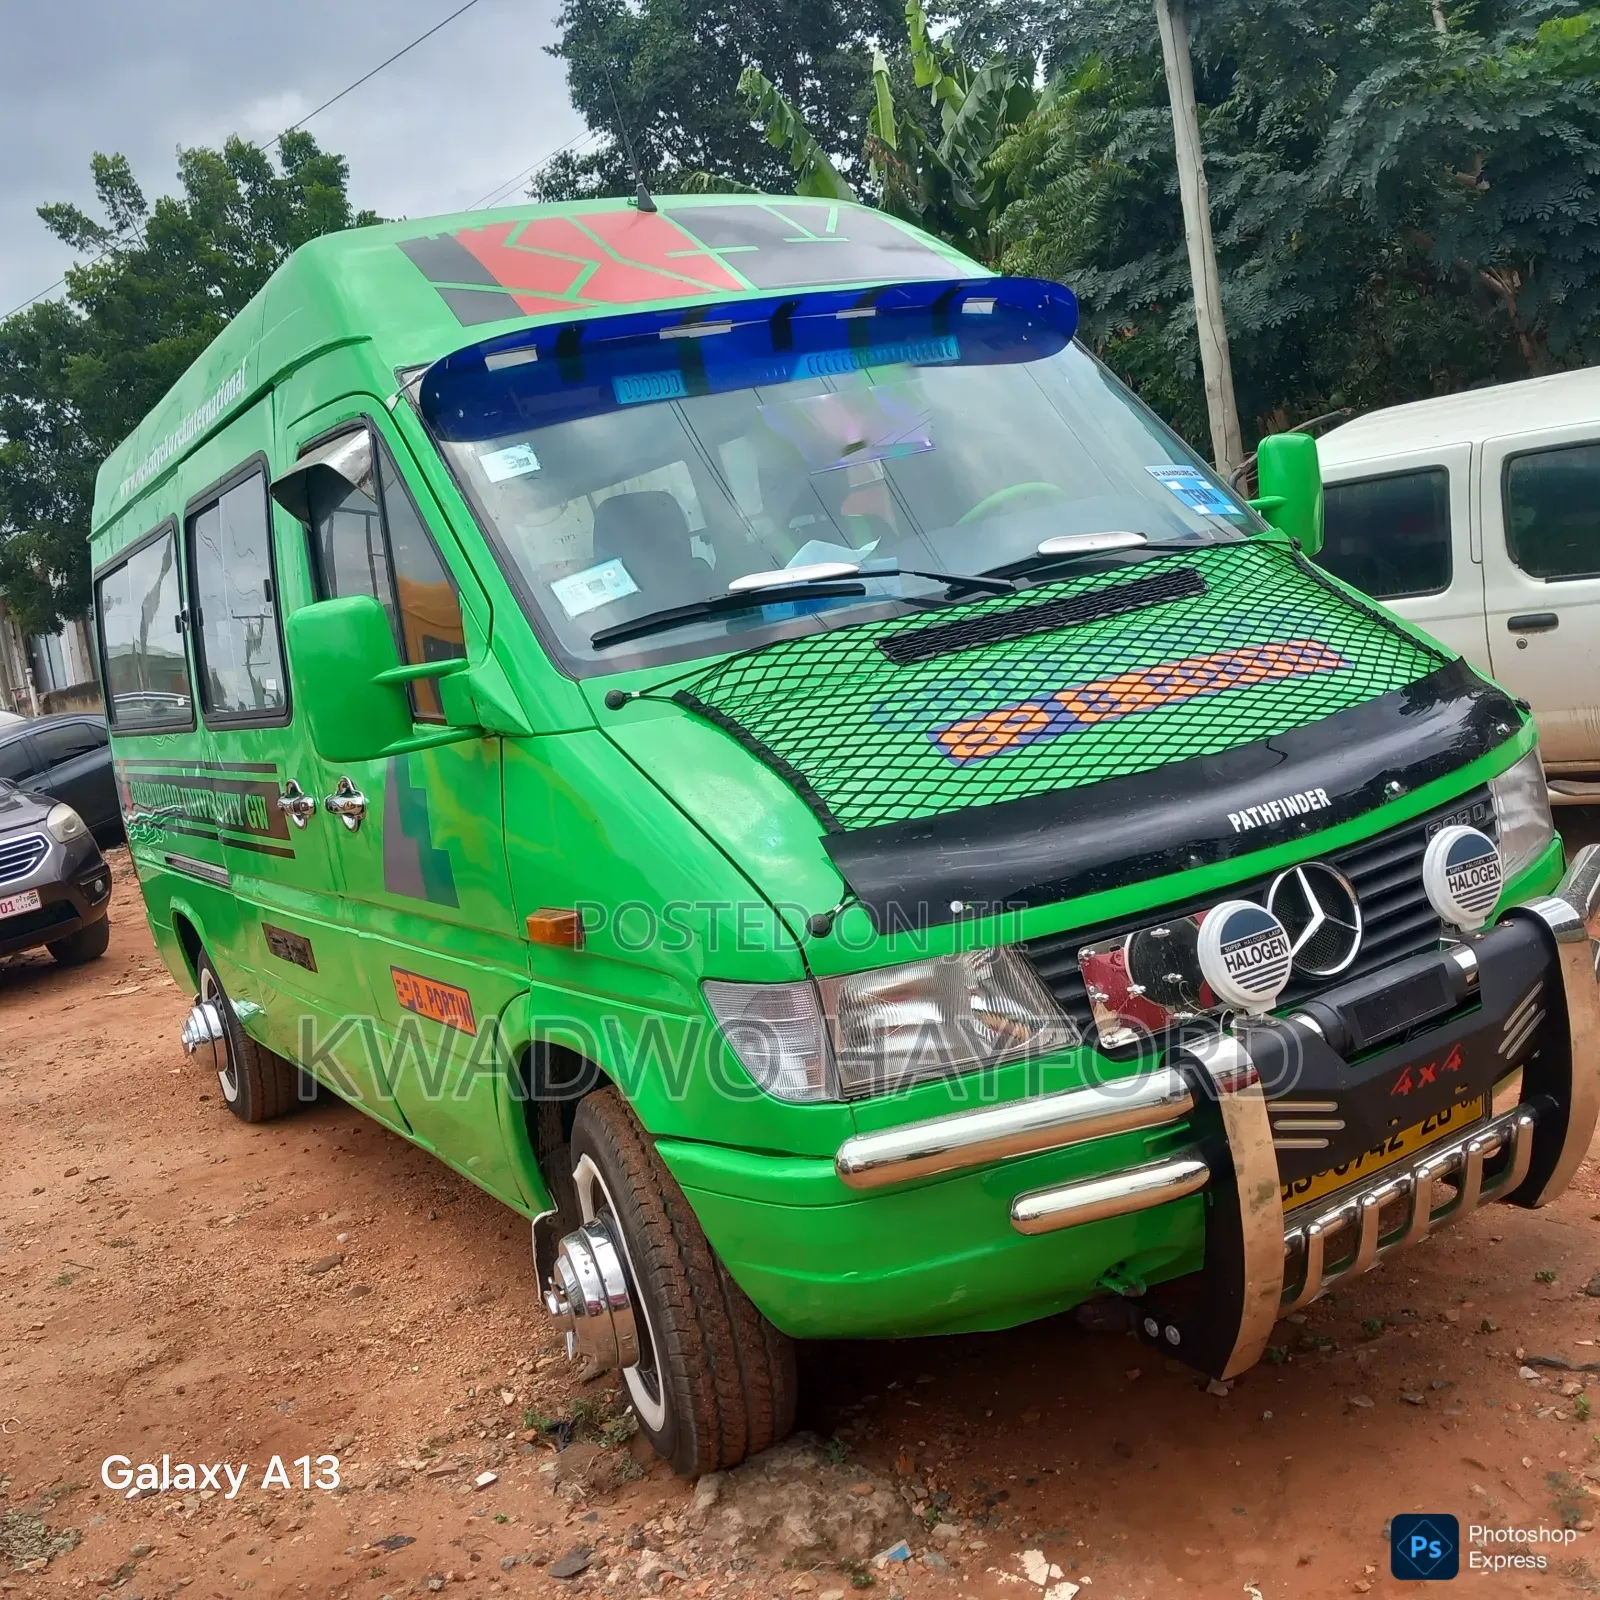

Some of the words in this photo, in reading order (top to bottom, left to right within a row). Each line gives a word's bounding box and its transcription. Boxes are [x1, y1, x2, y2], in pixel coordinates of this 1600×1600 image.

[245, 793, 269, 830] GW
[1227, 787, 1332, 833] PATHFINDER
[1448, 862, 1502, 894] HALOGEN
[1223, 943, 1242, 954] SUPER
[1243, 935, 1267, 947] HALOGEN
[1224, 936, 1289, 974] HALOGEN
[426, 986, 474, 1028] PORTIN
